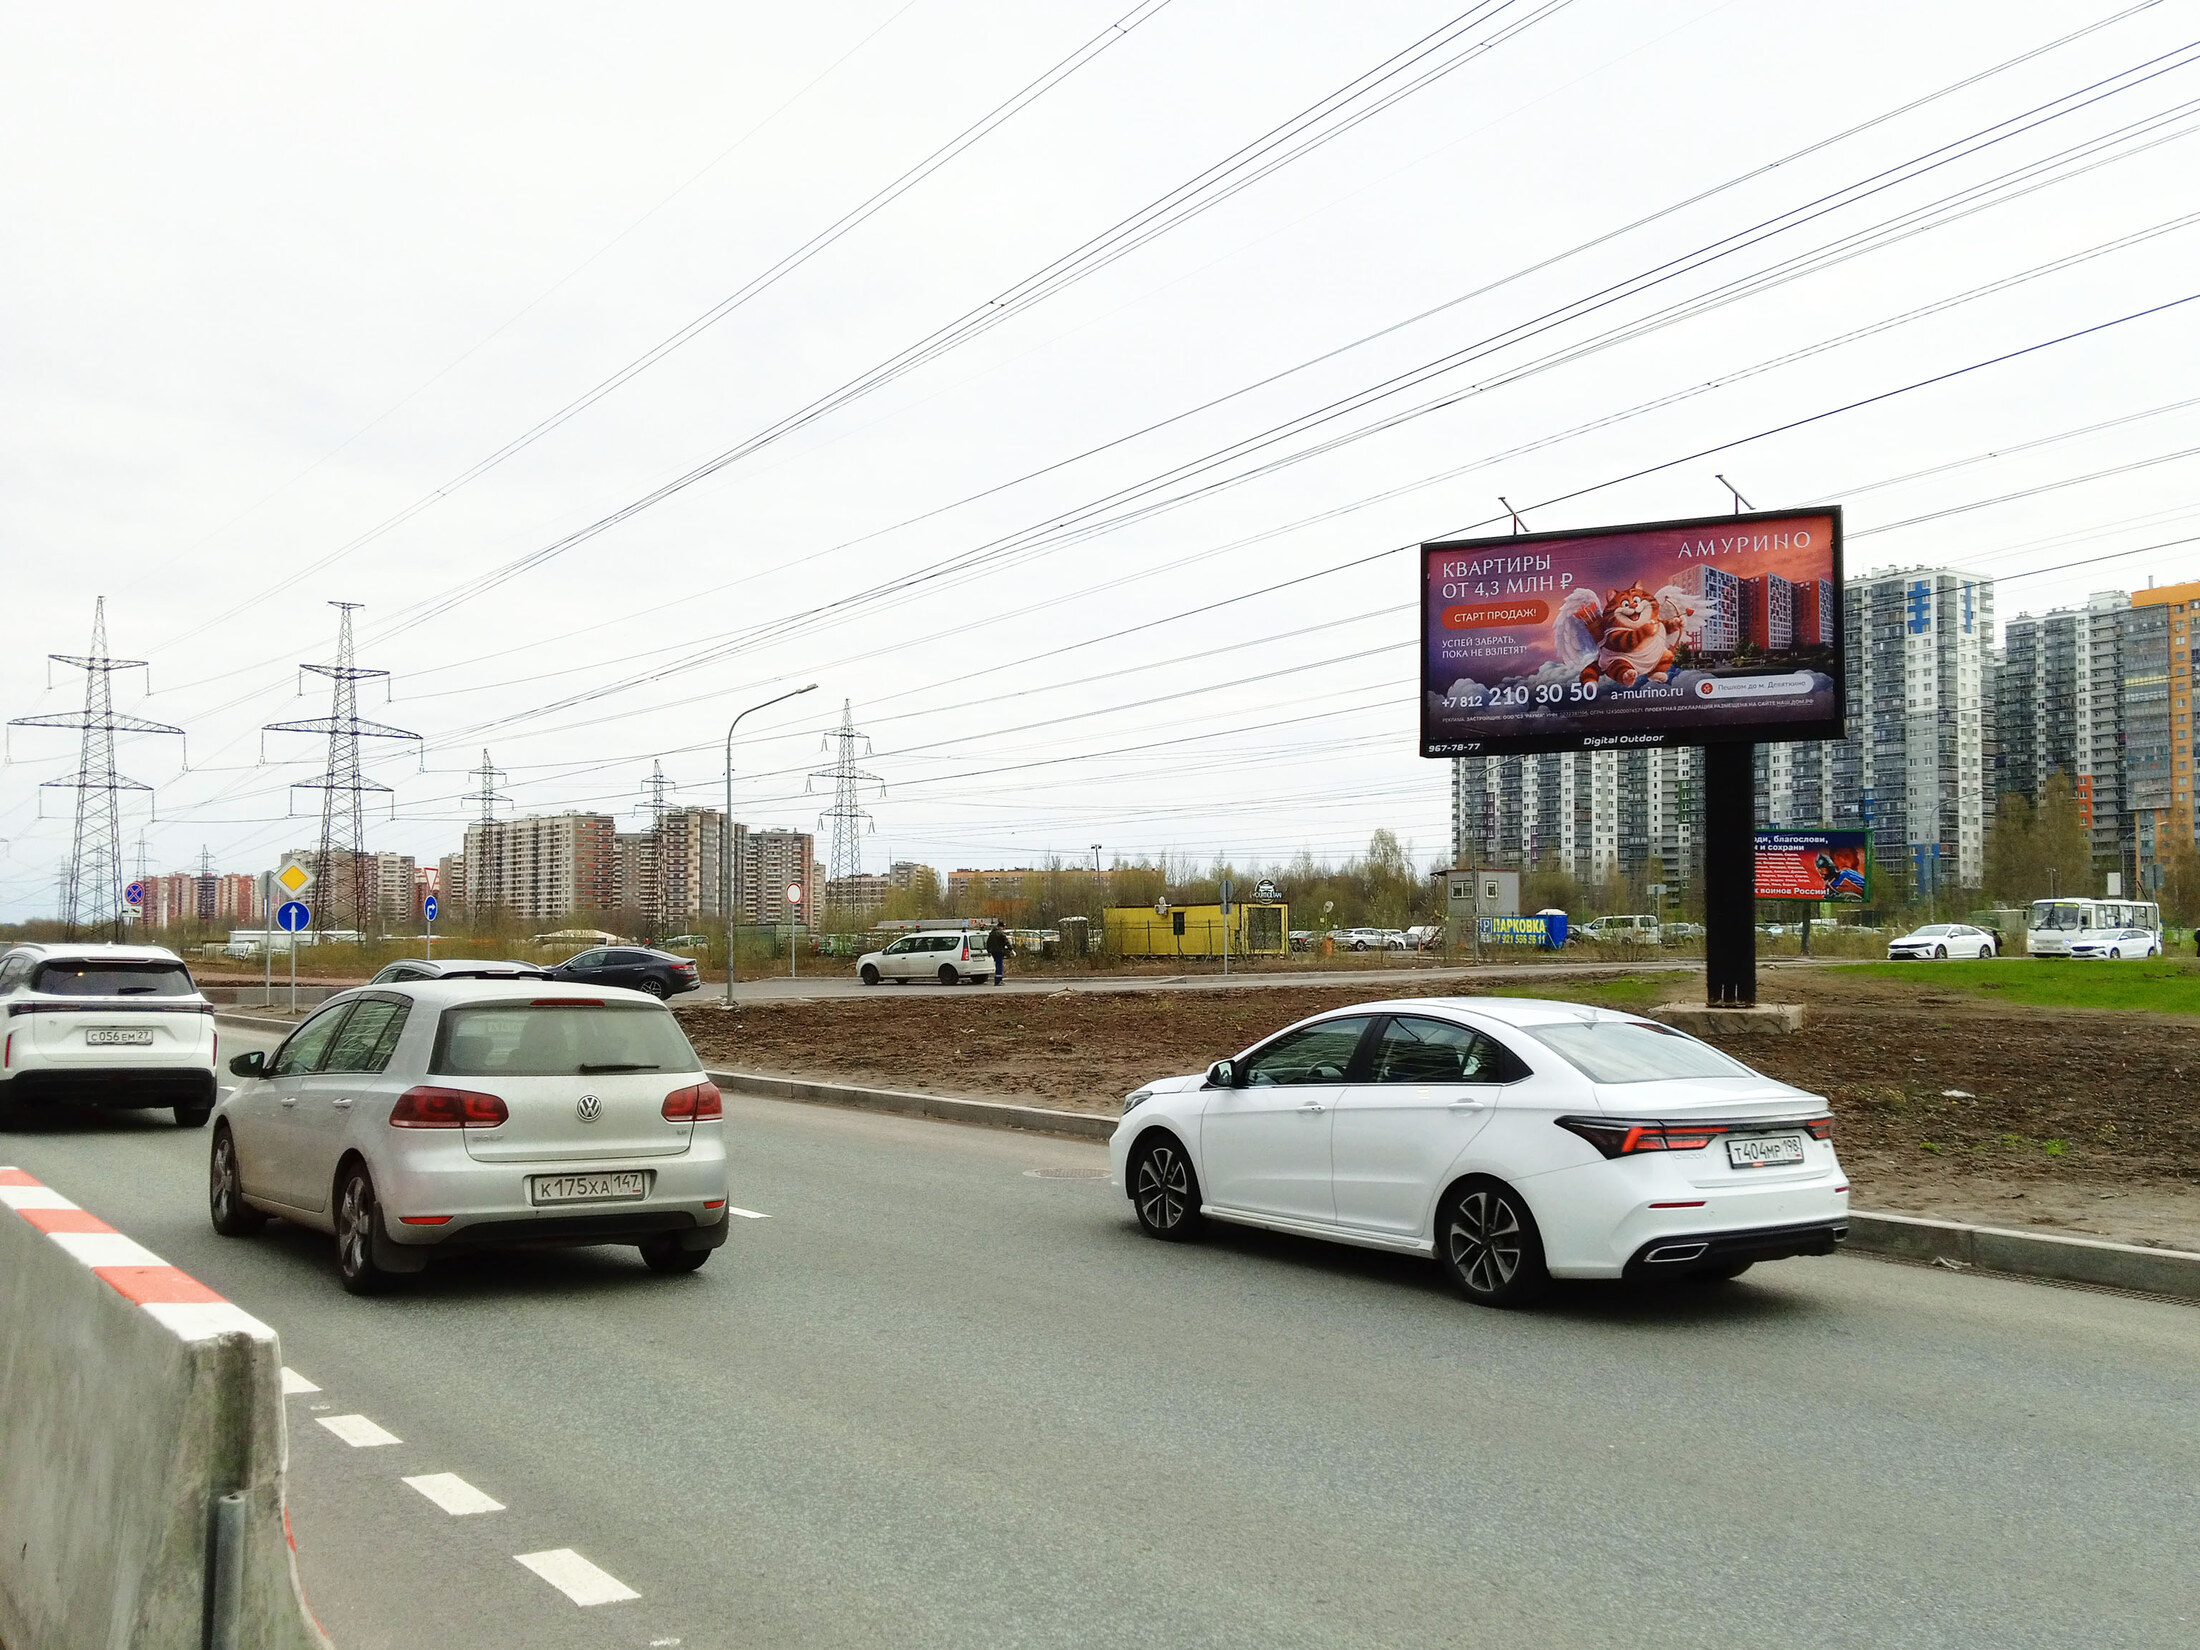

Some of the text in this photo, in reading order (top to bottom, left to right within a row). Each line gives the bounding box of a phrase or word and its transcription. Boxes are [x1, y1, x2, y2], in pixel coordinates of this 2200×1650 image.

[1678, 531, 1811, 559] АМУРИНО
[1443, 554, 1550, 578] КВАРТИРЫ
[1442, 582, 1469, 599] ОТ
[1474, 580, 1500, 598] 4,3
[1506, 576, 1553, 594] МЛН
[1454, 608, 1537, 623] СТАРТ ПРОДАЖ!
[1442, 635, 1516, 649] УСПЕЙ ЗАБРАТЬ,
[1442, 649, 1469, 659] ПОКА
[1471, 648, 1483, 657] НЕ
[1442, 681, 1597, 709] +7 812 210 30 50
[1611, 686, 1684, 700] a-murino.ru
[1428, 741, 1480, 753] 967-78-77
[1584, 734, 1664, 747] Digital Outdoor
[1773, 835, 1829, 844] благослови,
[1768, 845, 1805, 853] сохрани
[1794, 888, 1831, 896] России!
[1493, 918, 1546, 933] ПАРКОВКА
[541, 1175, 638, 1197] К175ХА 147
